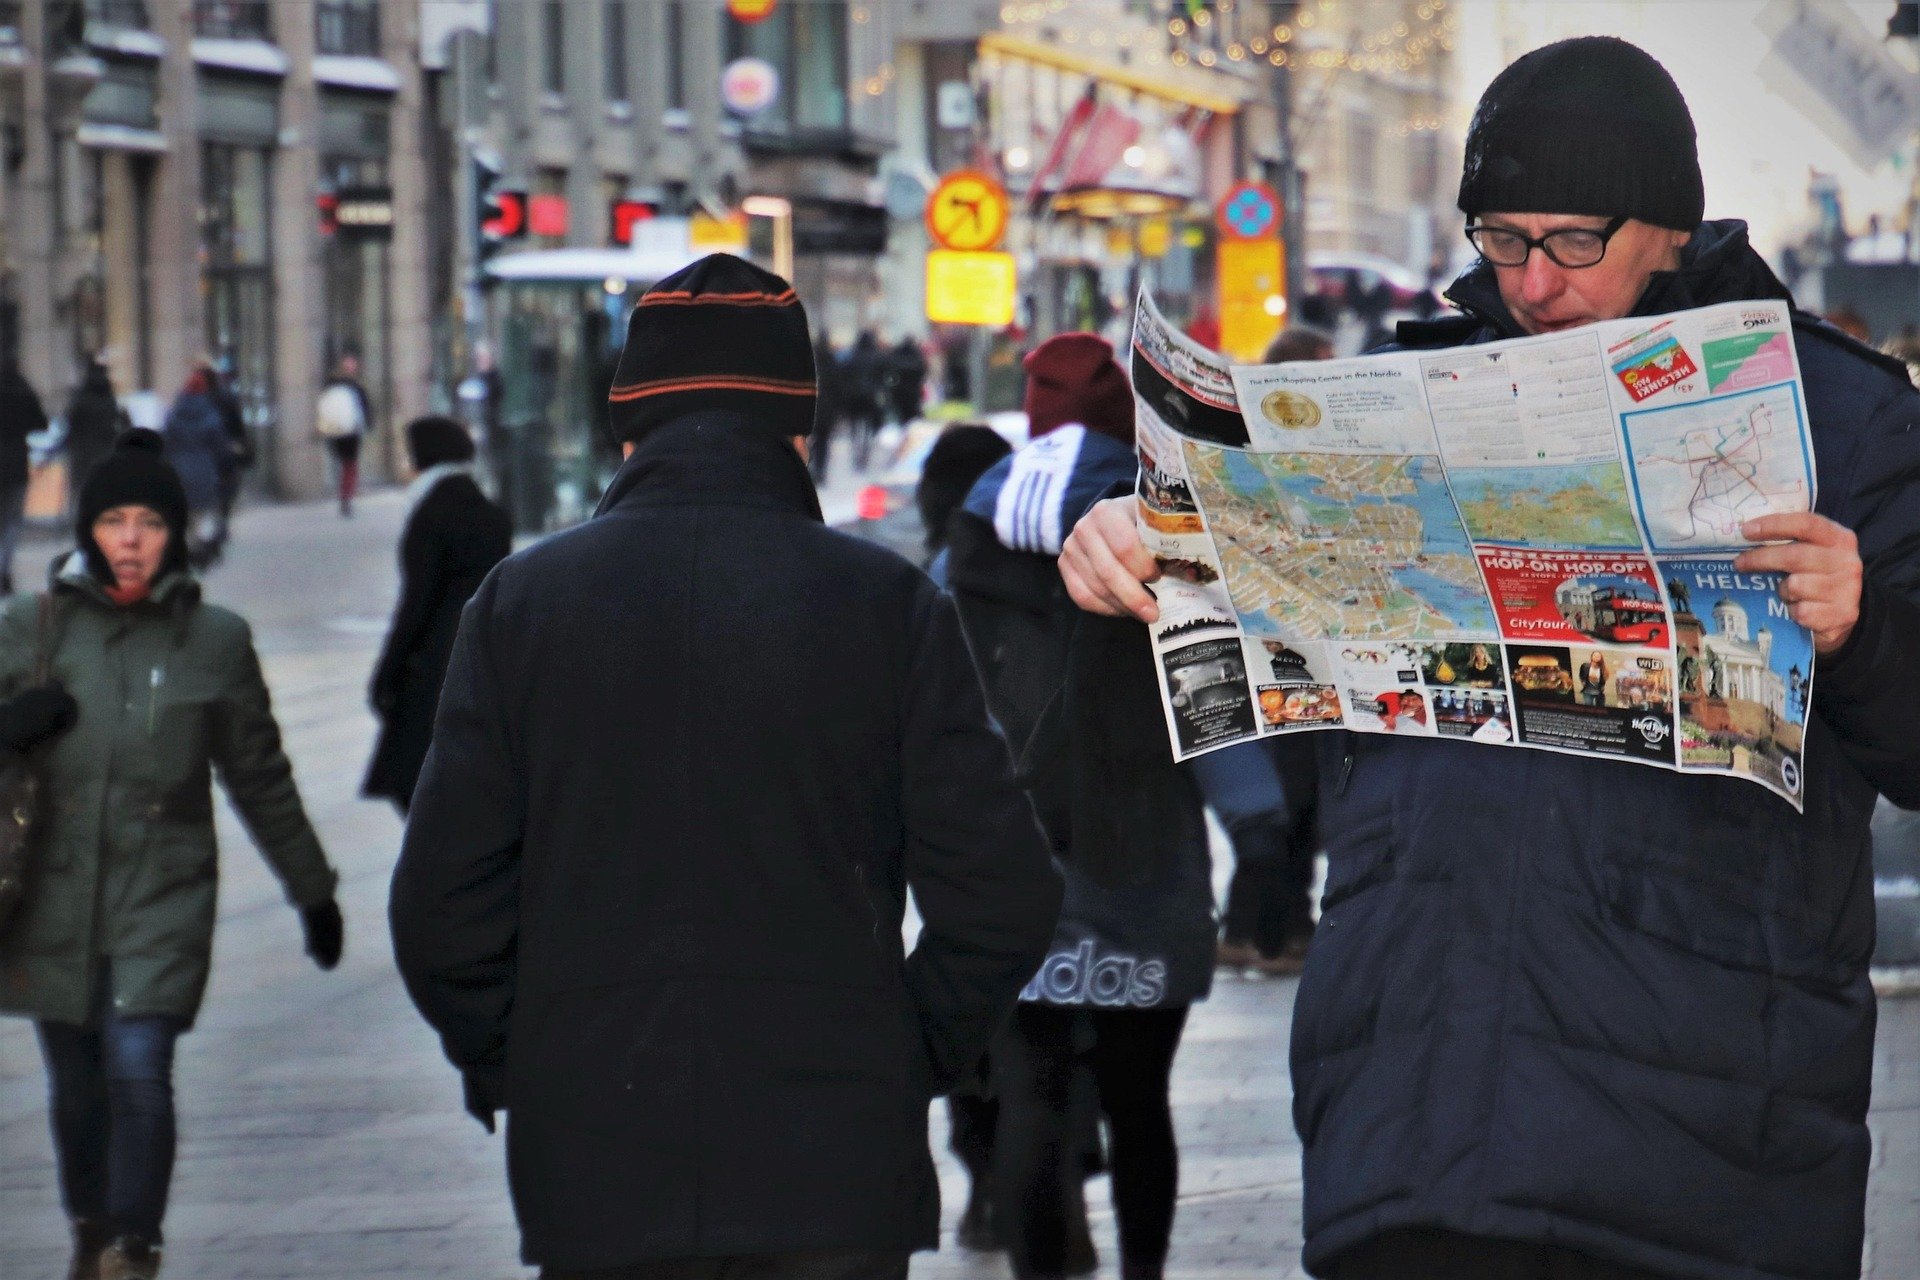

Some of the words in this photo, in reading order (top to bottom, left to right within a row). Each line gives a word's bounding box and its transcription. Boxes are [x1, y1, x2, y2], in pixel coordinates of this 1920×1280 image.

[1281, 375, 1317, 385] Shopping
[1318, 374, 1342, 383] Center
[1355, 371, 1368, 380] the
[1370, 370, 1402, 381] Nordics
[1632, 375, 1652, 390] PASS
[1635, 365, 1691, 399] HELSINKI
[1484, 558, 1560, 574] HOP-ON
[1564, 562, 1648, 575] HOP-OFF
[1670, 561, 1736, 573] WELCOME
[1694, 573, 1783, 592] HELSI
[1767, 596, 1791, 621] M
[1631, 718, 1653, 732] Hard
[1018, 938, 1167, 1007] das
